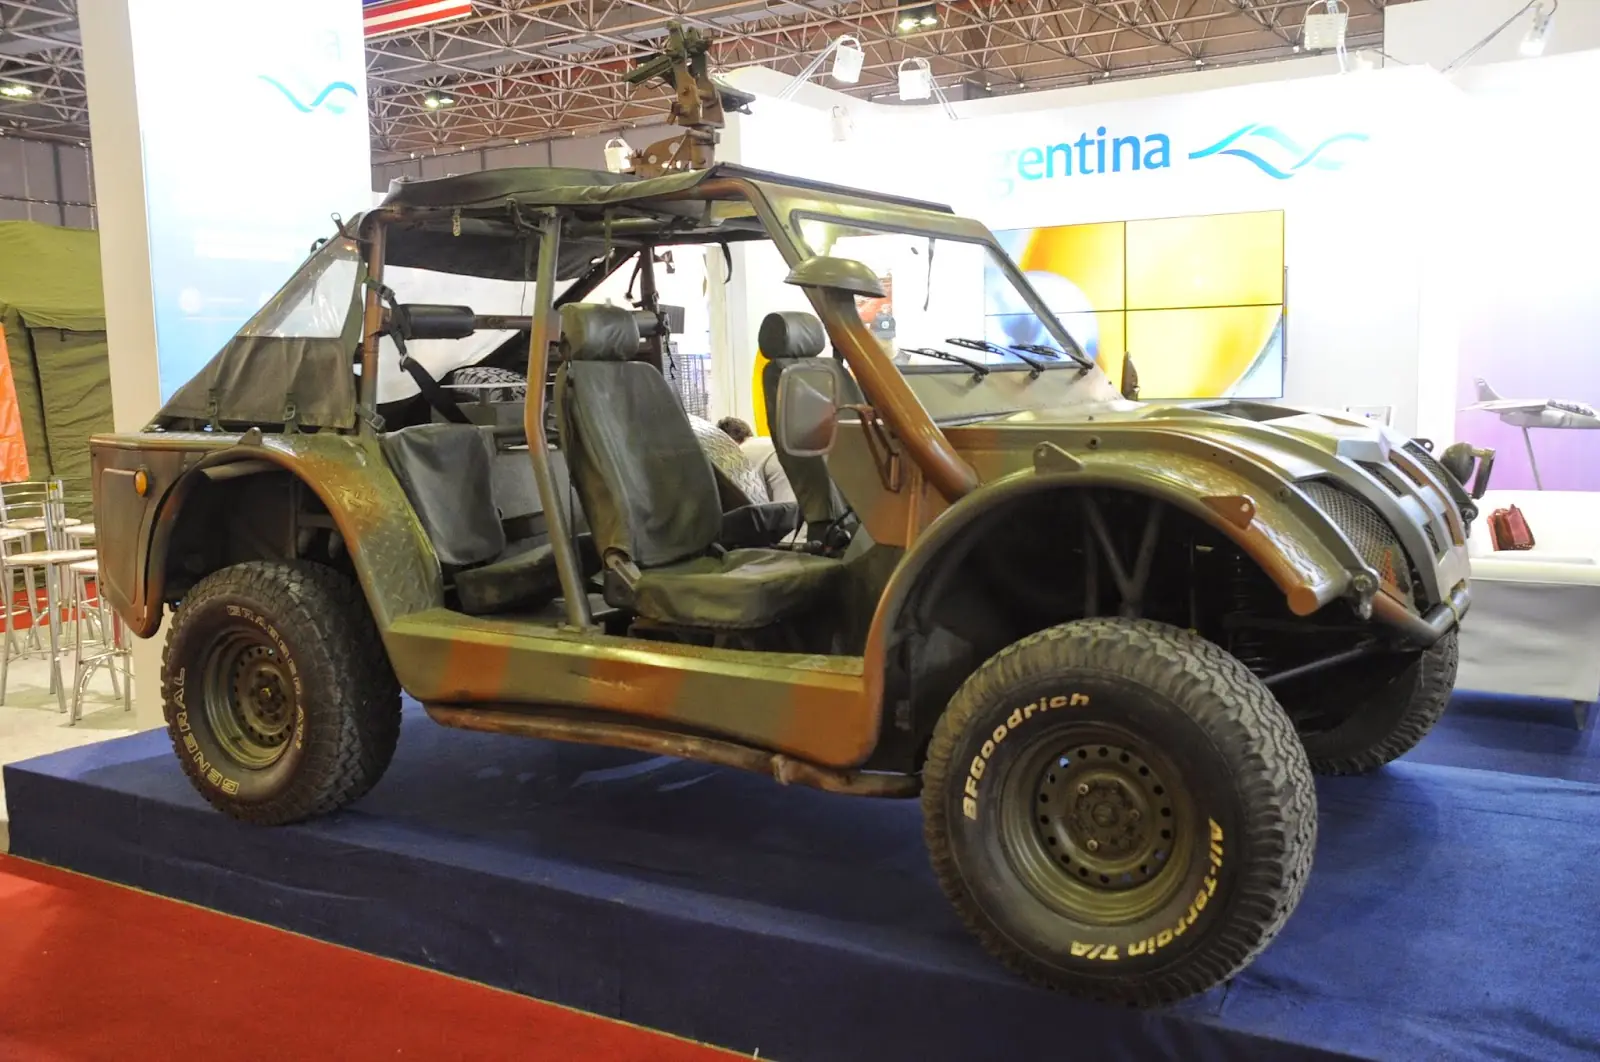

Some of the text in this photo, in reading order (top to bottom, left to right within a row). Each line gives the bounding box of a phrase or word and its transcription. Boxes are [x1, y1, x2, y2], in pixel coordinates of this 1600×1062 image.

[174, 667, 240, 796] GENERAL
[962, 692, 1090, 821] BFGoodrich
[1070, 816, 1224, 960] All-Terrain T/A
